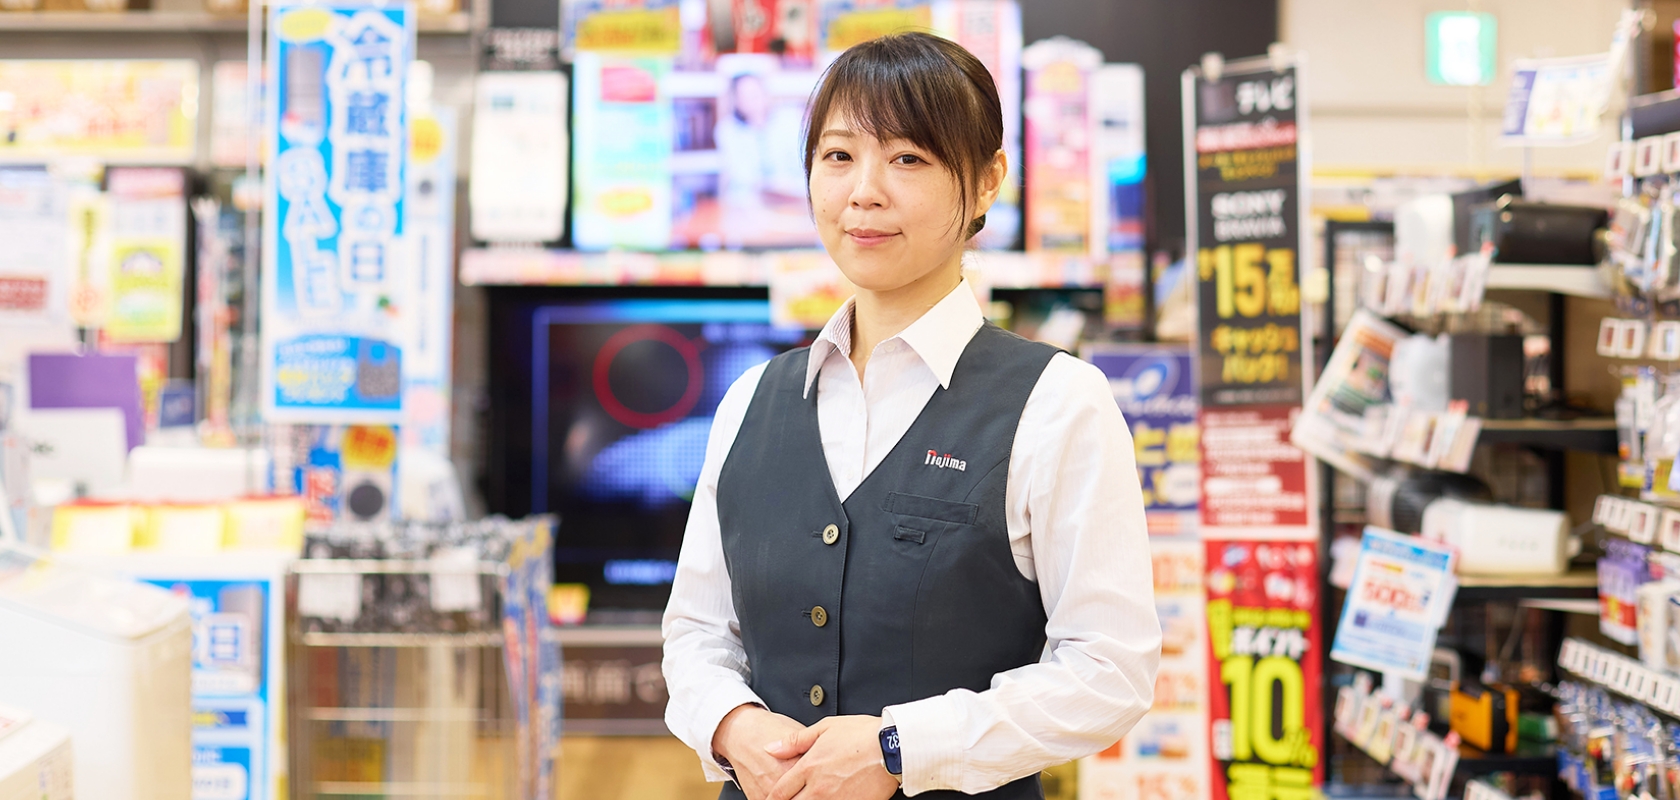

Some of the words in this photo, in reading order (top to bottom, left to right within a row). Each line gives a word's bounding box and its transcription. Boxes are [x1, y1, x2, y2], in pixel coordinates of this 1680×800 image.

[1235, 76, 1294, 116] テレビ
[340, 24, 396, 283] 冷蔵庫の日
[1211, 190, 1285, 219] SONY
